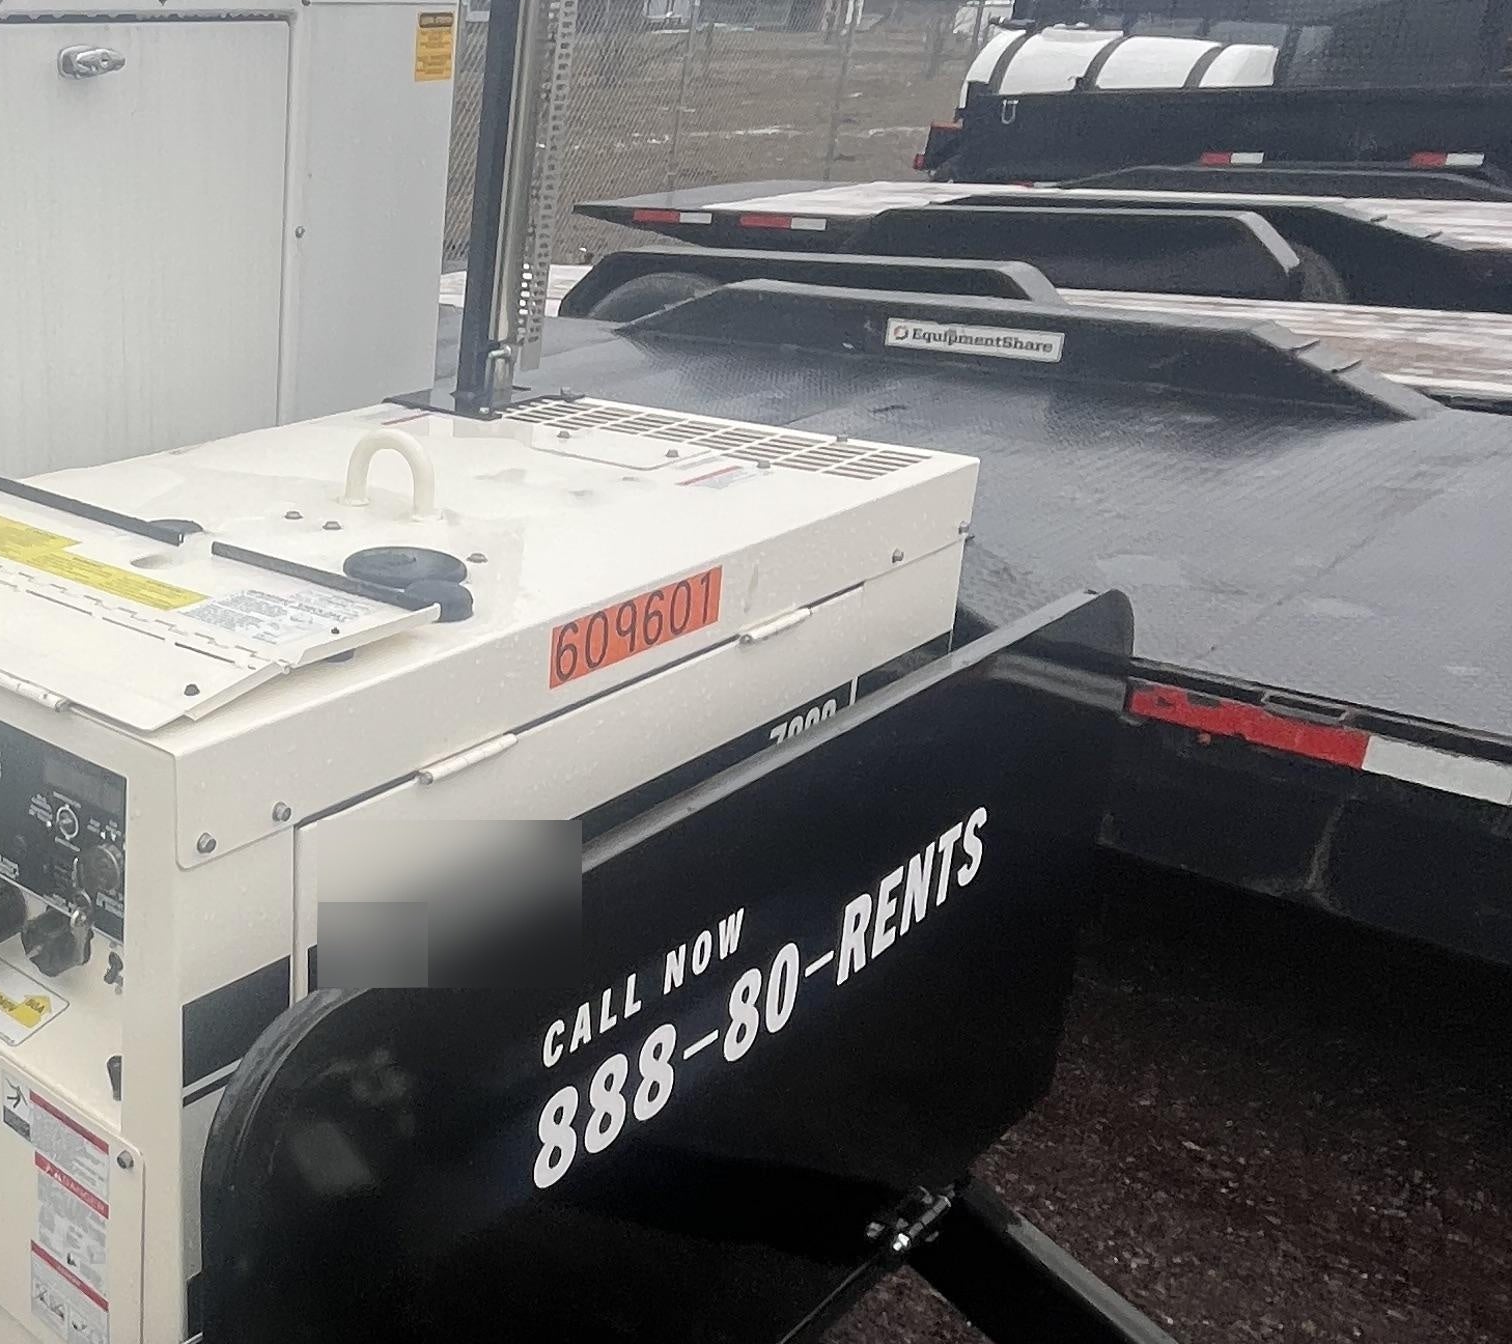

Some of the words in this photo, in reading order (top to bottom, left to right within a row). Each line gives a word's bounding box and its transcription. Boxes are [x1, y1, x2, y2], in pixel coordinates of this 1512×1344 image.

[912, 327, 1053, 353] EquipmentShare
[556, 569, 713, 682] 609601
[533, 806, 987, 1189] 888-80-RENTS
[543, 973, 642, 1068] CALL
[663, 907, 745, 995] NOW
